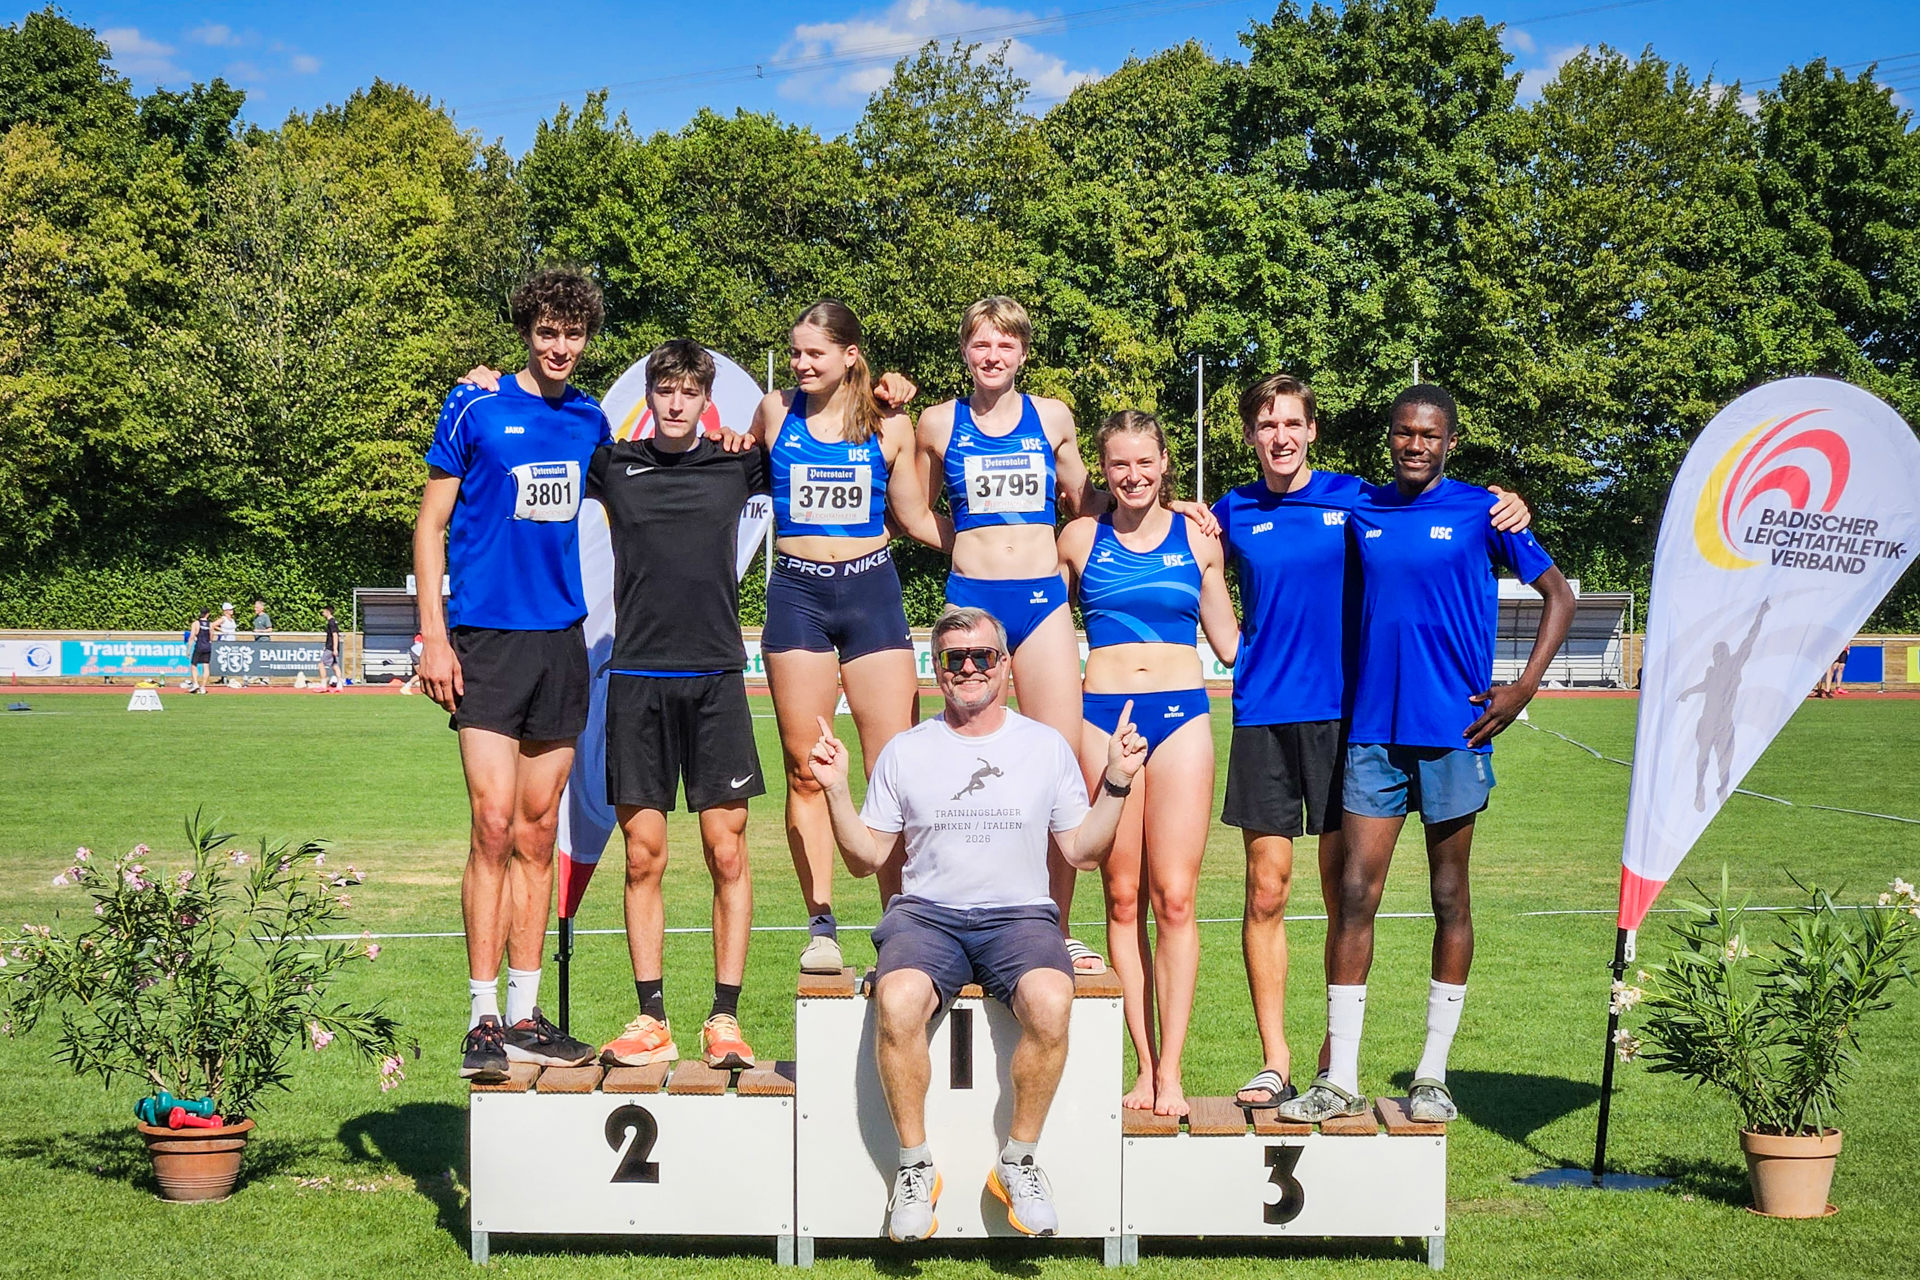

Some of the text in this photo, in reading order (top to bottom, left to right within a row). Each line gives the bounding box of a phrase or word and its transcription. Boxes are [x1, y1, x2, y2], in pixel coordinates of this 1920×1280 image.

[504, 426, 525, 434] JAKO
[1021, 438, 1043, 451] USC
[847, 448, 870, 462] USC
[983, 457, 1028, 470] Peterstaler
[531, 466, 566, 477] Peterstaler
[809, 468, 853, 480] Peterstaler
[975, 473, 1039, 498] 3795
[526, 481, 571, 506] 3801
[798, 485, 863, 509] 3789
[1323, 511, 1345, 526] USC
[1759, 508, 1879, 537] BADISCHER
[1251, 521, 1274, 535] JAKO
[1429, 525, 1453, 541] USC
[1743, 526, 1908, 560] LEICHTATHLETIK-
[787, 557, 836, 578] PRO
[843, 549, 889, 577] NIKE
[1162, 554, 1185, 567] USC
[1771, 548, 1867, 575] VERBAND
[80, 641, 188, 656] Trautmann
[133, 695, 147, 706] 70
[1163, 711, 1185, 719] erima
[934, 808, 1022, 818] TRAININGSLAGER
[934, 821, 1023, 831] BRIXEN / ITALIEN
[965, 834, 991, 844] 2026
[950, 1008, 973, 1090] 1
[605, 1104, 660, 1184] 2
[1263, 1145, 1305, 1225] 3
